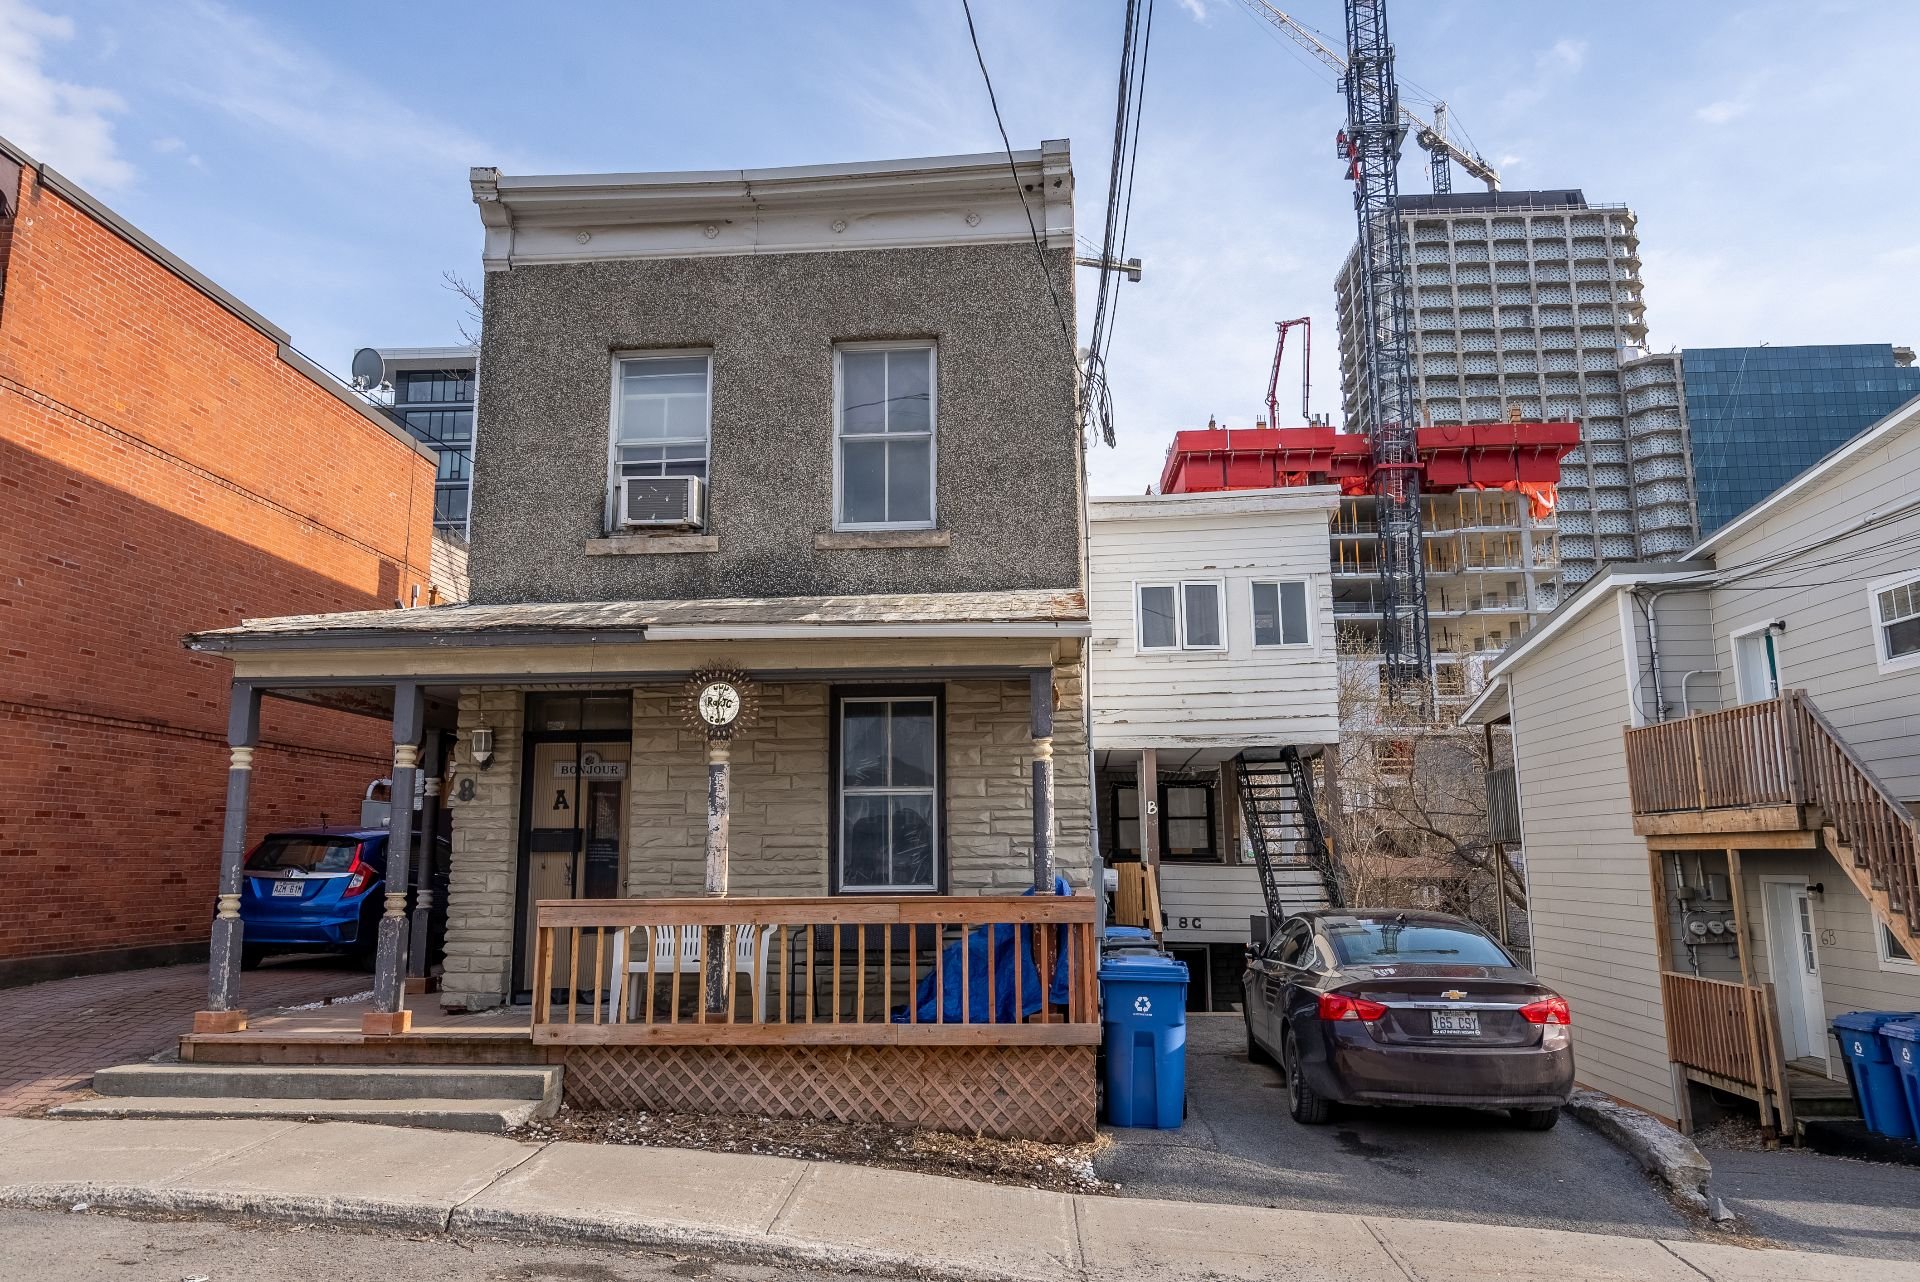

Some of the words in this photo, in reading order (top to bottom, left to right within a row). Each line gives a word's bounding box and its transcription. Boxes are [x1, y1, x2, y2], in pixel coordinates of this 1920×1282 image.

[560, 765, 619, 775] BONJOUR
[458, 778, 475, 801] 8
[552, 789, 570, 811] A
[1147, 800, 1158, 815] B
[1432, 1016, 1453, 1029] Y65
[1458, 1017, 1477, 1030] CSY
